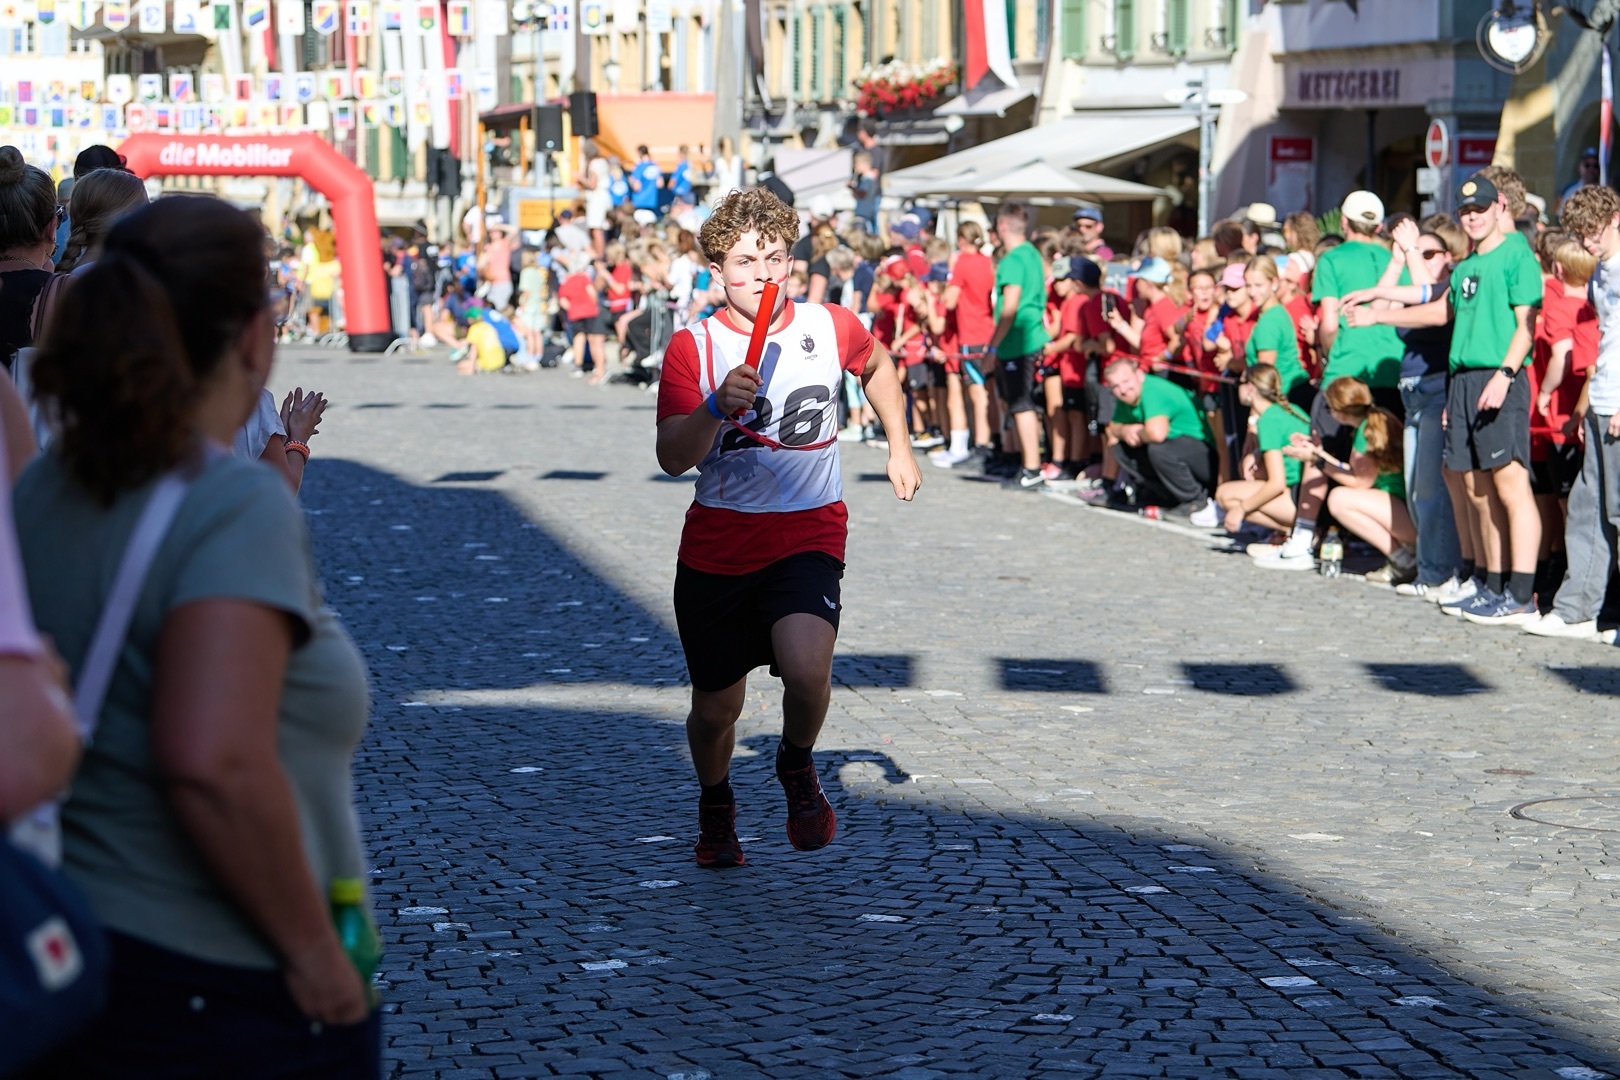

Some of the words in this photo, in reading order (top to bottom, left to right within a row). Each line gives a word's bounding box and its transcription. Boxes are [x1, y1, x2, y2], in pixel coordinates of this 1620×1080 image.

[1299, 68, 1400, 100] METZGEREI
[160, 141, 194, 166] die
[196, 143, 293, 167] Mobiliar
